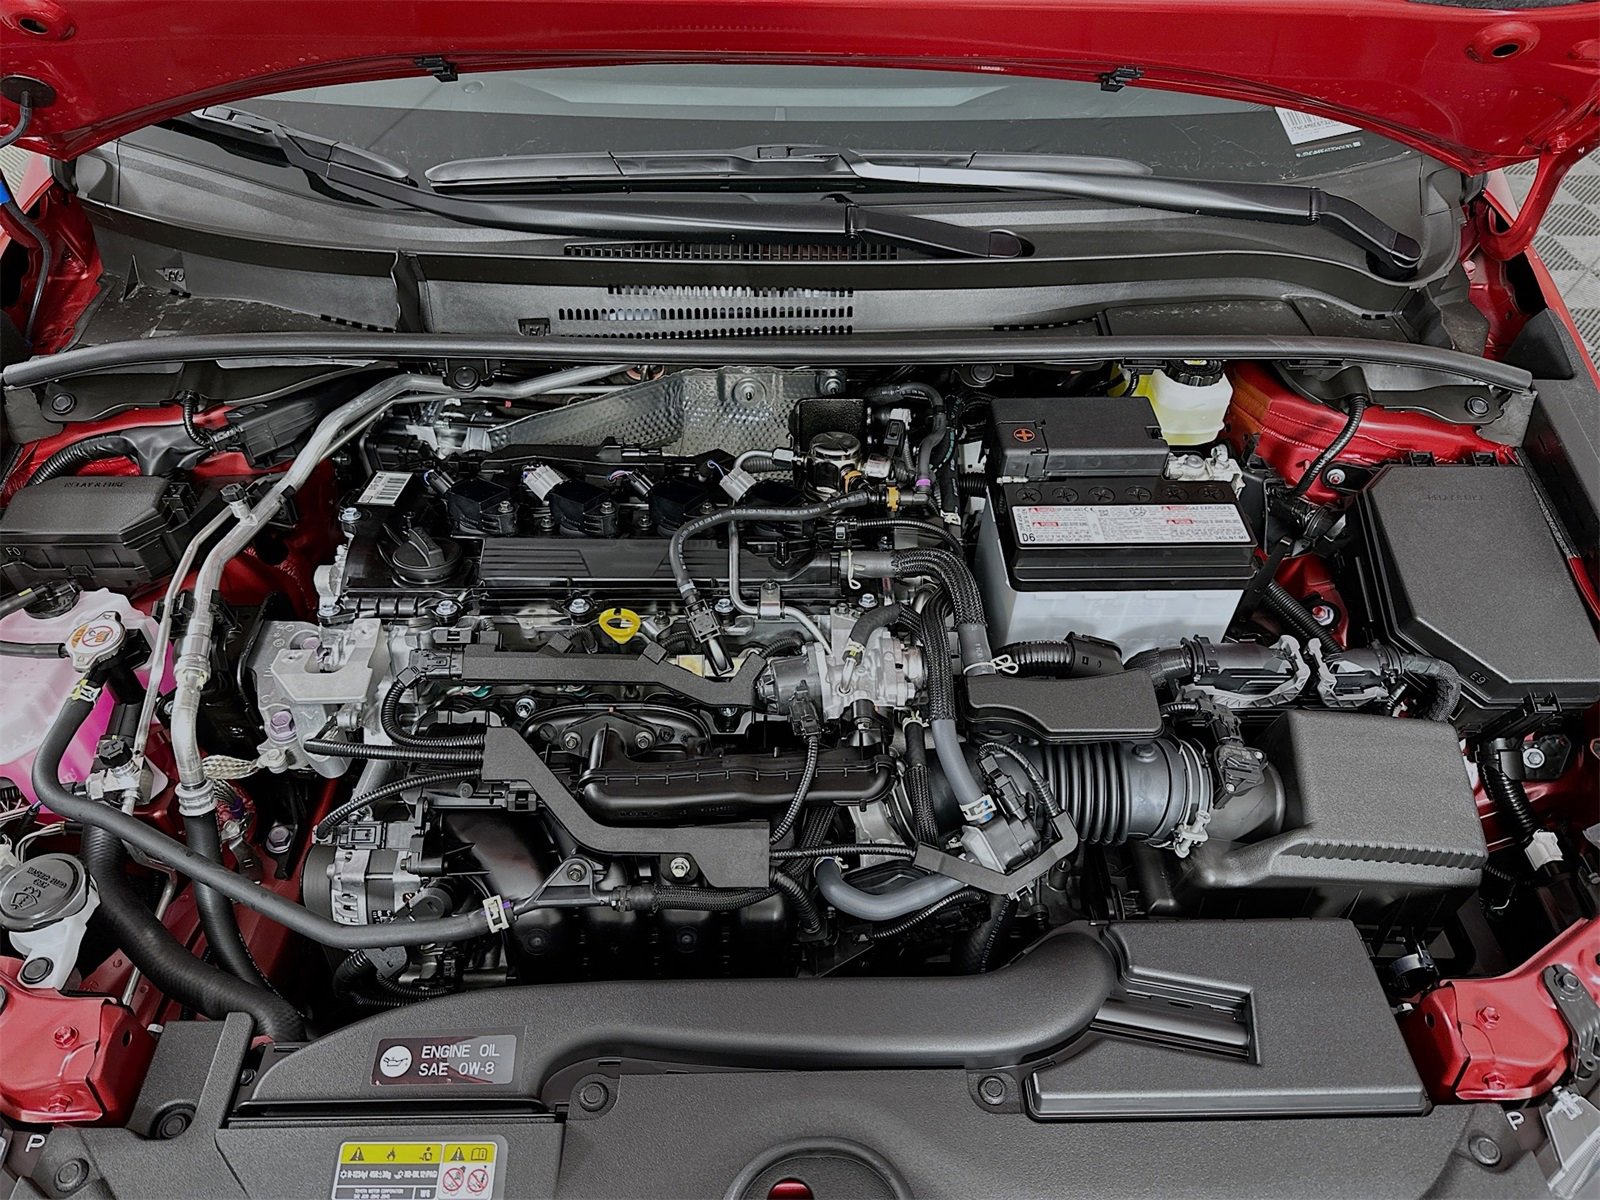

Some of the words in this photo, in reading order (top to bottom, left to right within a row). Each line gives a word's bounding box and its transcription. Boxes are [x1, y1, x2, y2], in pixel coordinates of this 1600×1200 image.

[1021, 532, 1036, 542] D6
[421, 1044, 472, 1059] ENGINE
[479, 1043, 500, 1058] OIL
[418, 1062, 450, 1077] SAE
[1506, 1111, 1525, 1131] P
[25, 1134, 46, 1153] P
